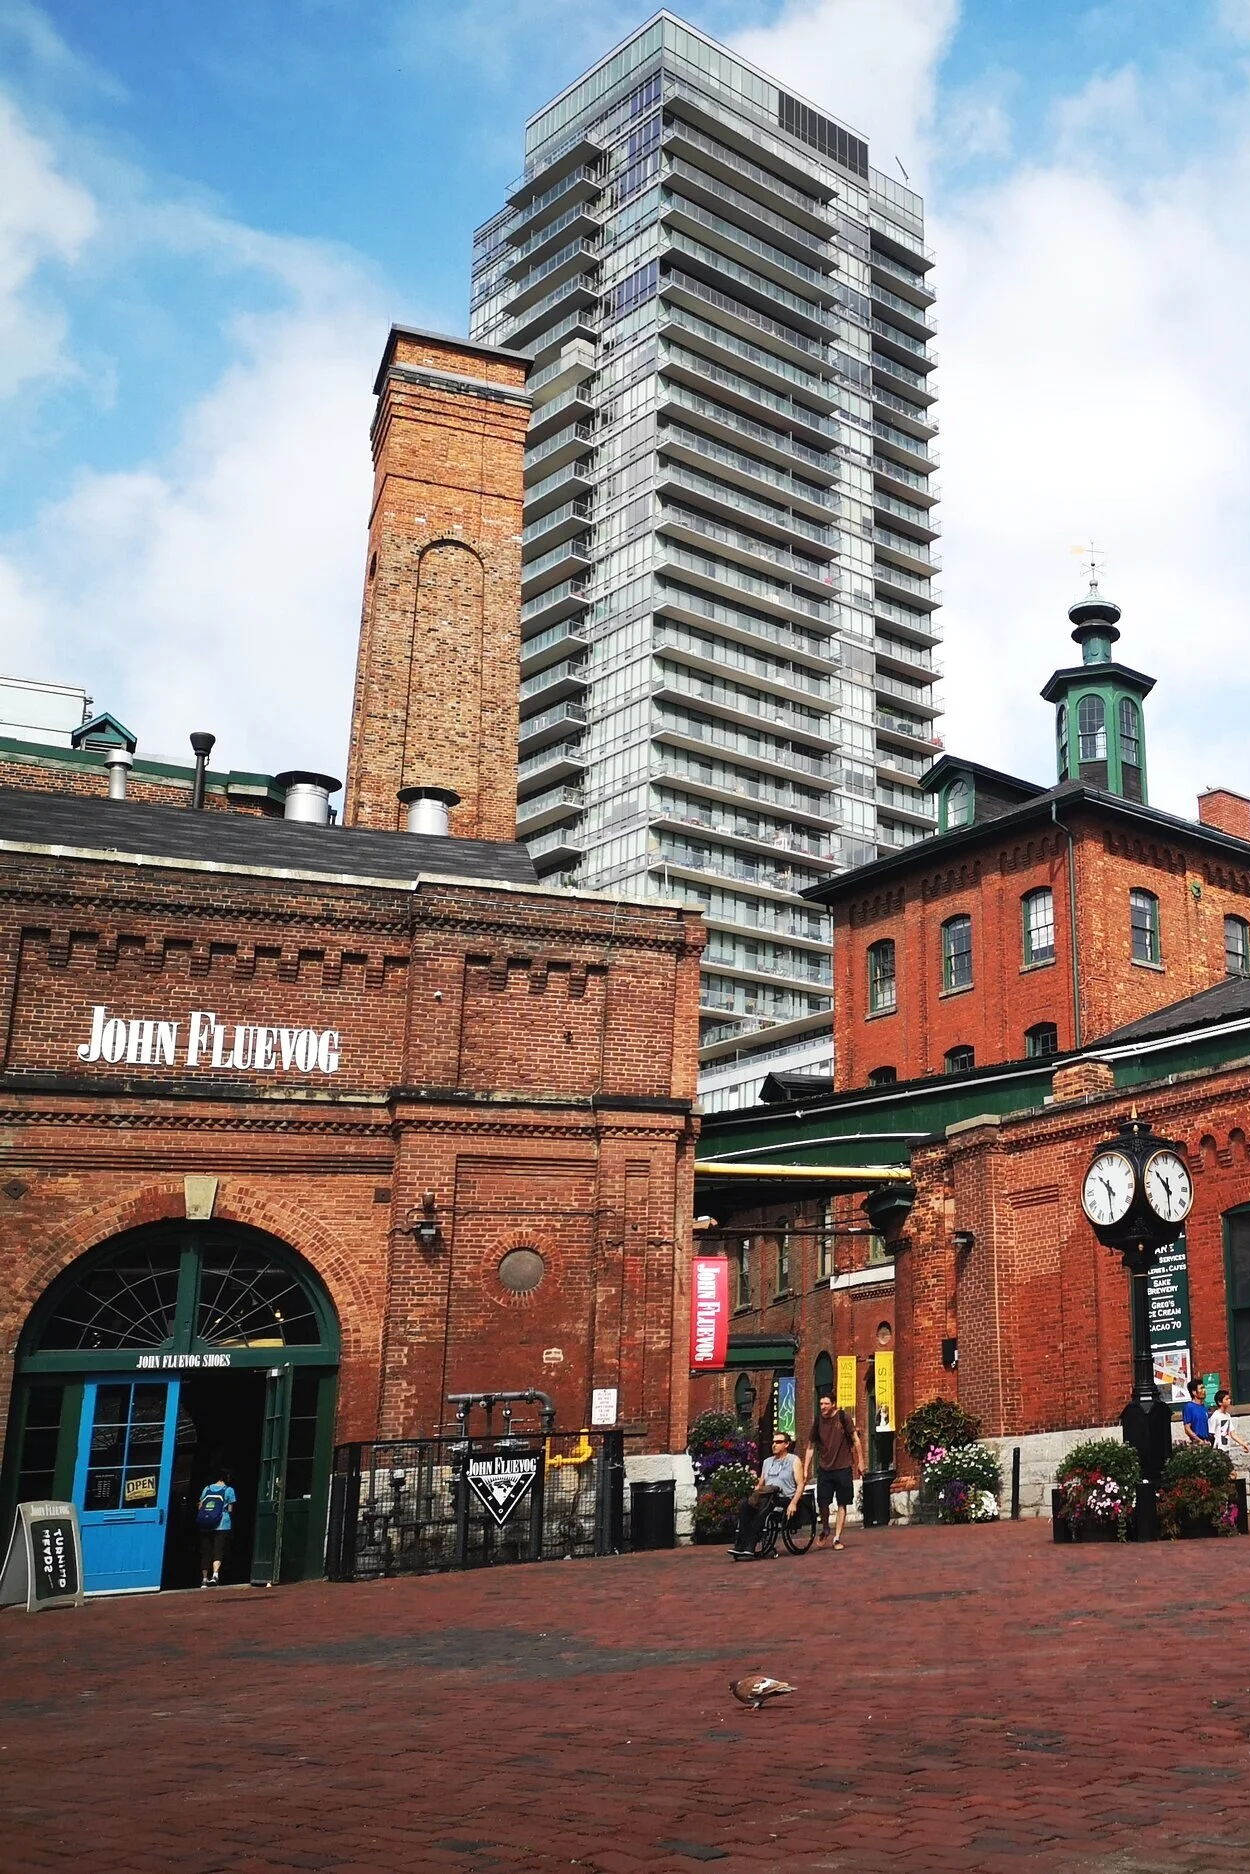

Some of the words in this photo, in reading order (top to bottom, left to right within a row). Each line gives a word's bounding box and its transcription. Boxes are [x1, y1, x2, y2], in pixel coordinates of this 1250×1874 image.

[184, 1011, 340, 1075] FLUEVOG
[1153, 1279, 1171, 1288] SAKE
[1147, 1285, 1178, 1295] BREWERY
[1151, 1300, 1175, 1309] GREG'S
[1157, 1308, 1181, 1317] CREAM
[694, 1301, 721, 1362] FLUEVOG
[1171, 1321, 1182, 1330] 70
[136, 1355, 161, 1369] JOHN
[162, 1354, 201, 1368] FLUEVOG
[202, 1354, 231, 1367] SHOES
[465, 1458, 493, 1477] JOHN
[494, 1456, 537, 1474] FLUEVOG
[126, 1477, 155, 1493] OPEN
